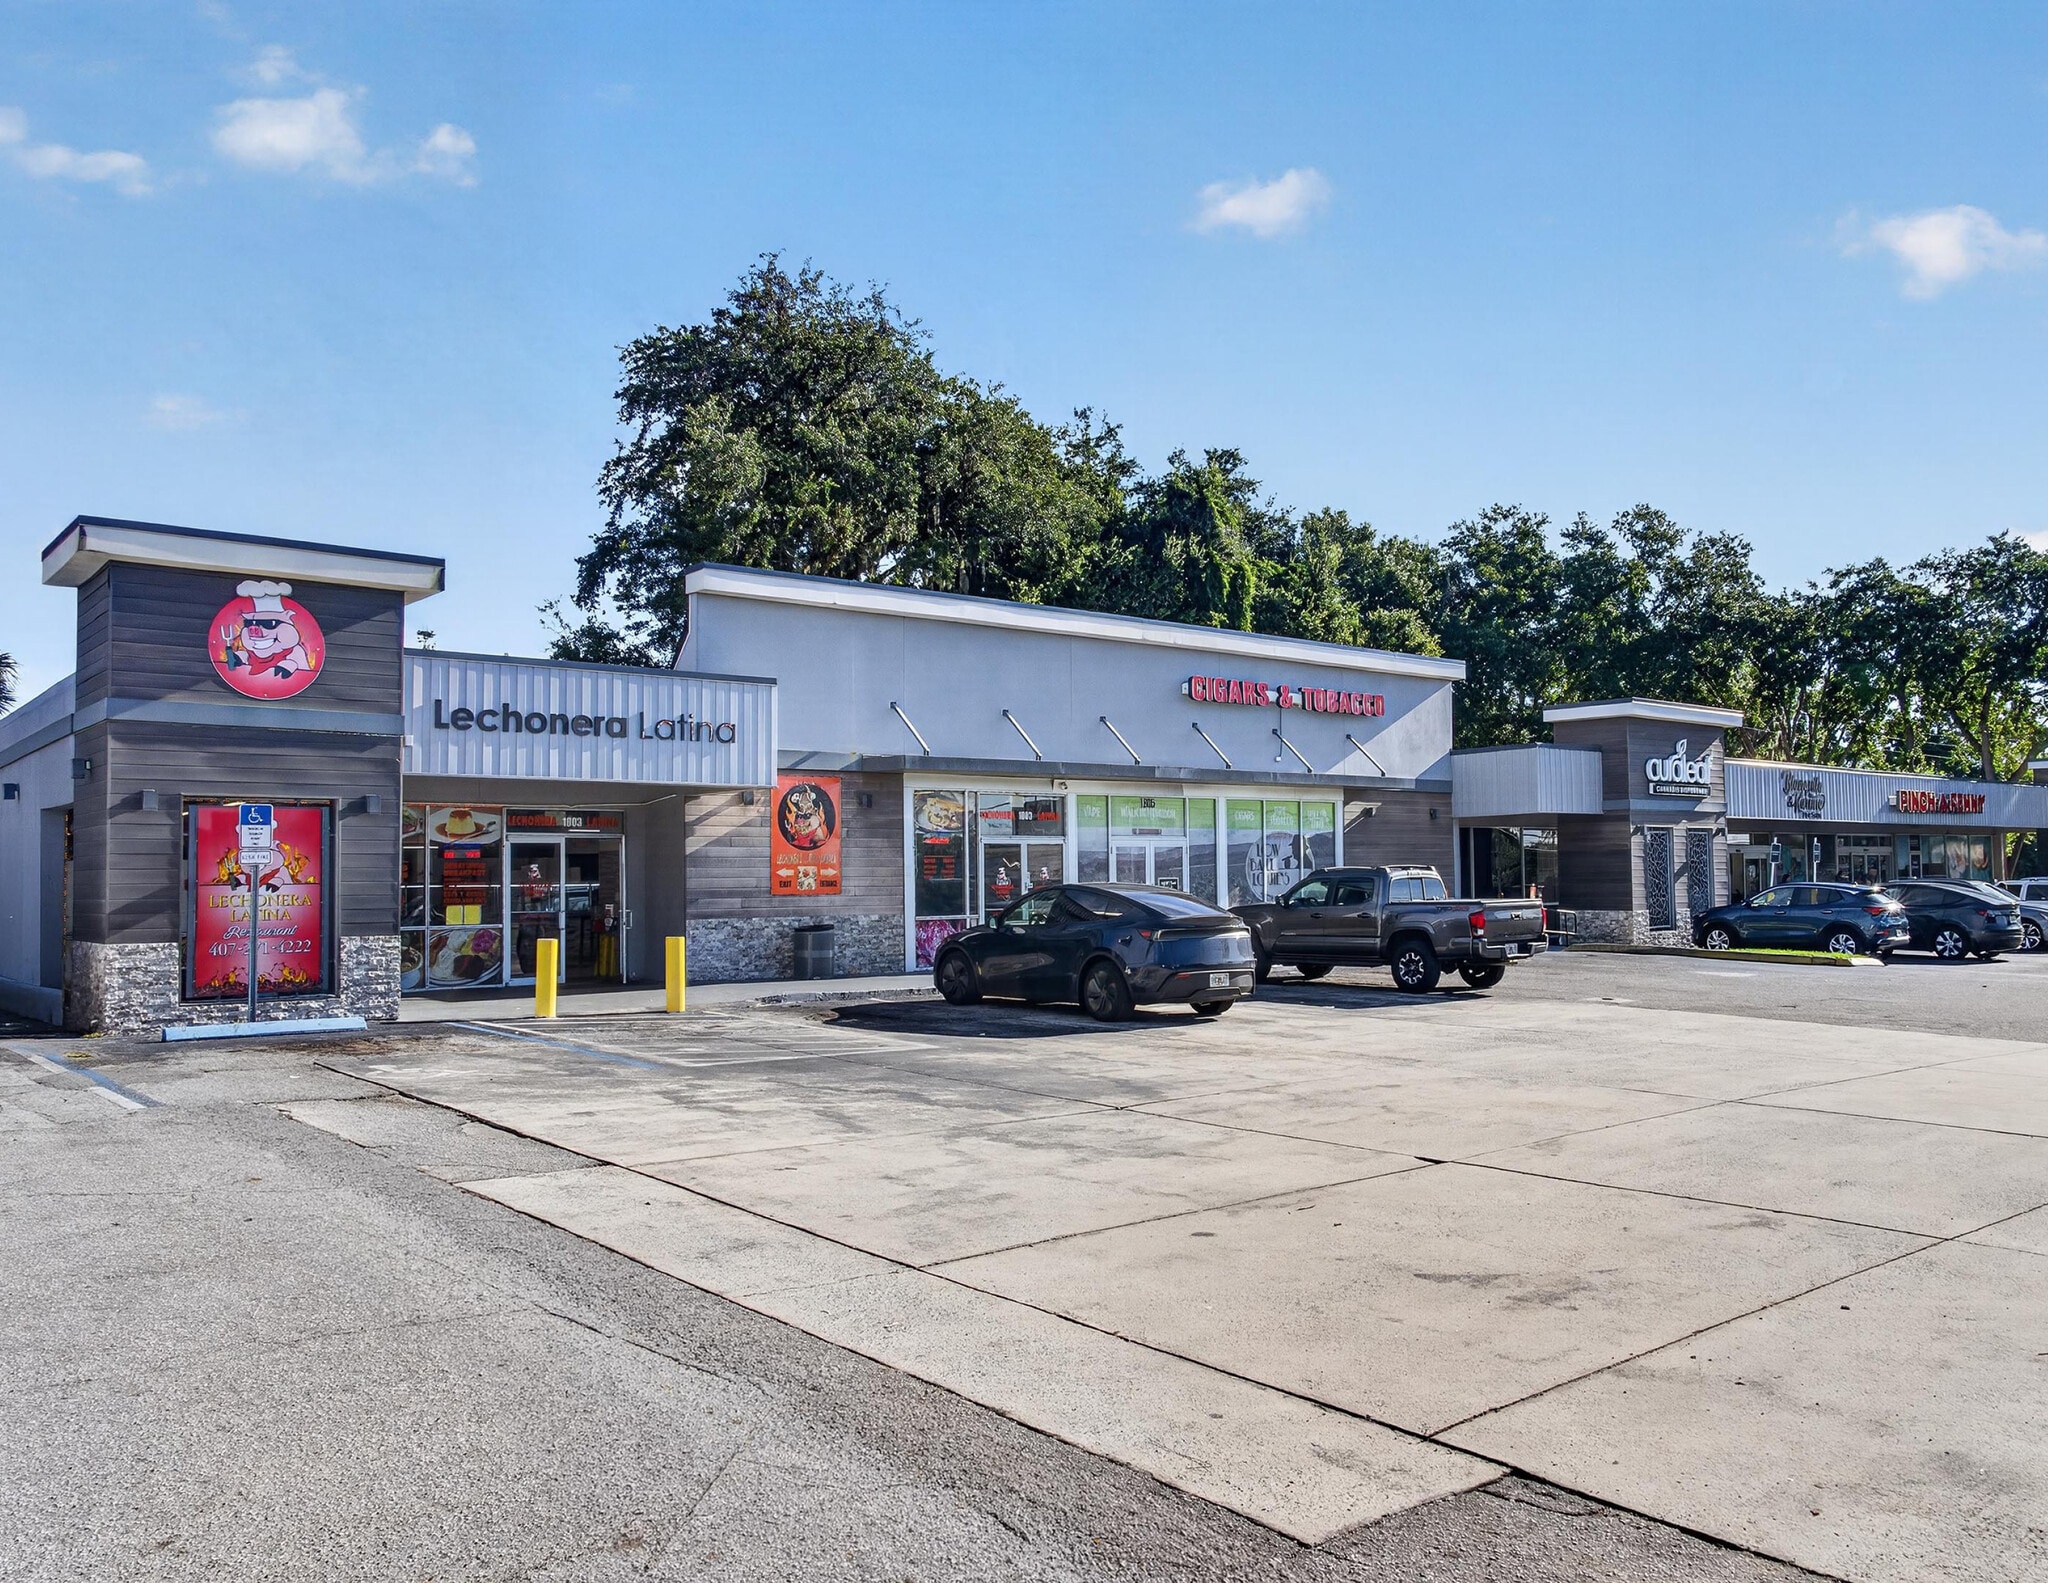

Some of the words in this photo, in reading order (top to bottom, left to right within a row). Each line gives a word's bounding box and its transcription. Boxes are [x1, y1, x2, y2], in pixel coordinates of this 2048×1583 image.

[1189, 675, 1270, 706] CIGARS
[1276, 685, 1293, 709] &
[1299, 687, 1386, 717] TOBACCO
[433, 699, 628, 738] Lechonera
[639, 711, 736, 744] Latina
[562, 816, 583, 828] 1803
[1256, 843, 1280, 858] LOW
[779, 880, 792, 889] EXIT
[208, 938, 312, 957] 407-21-4222
